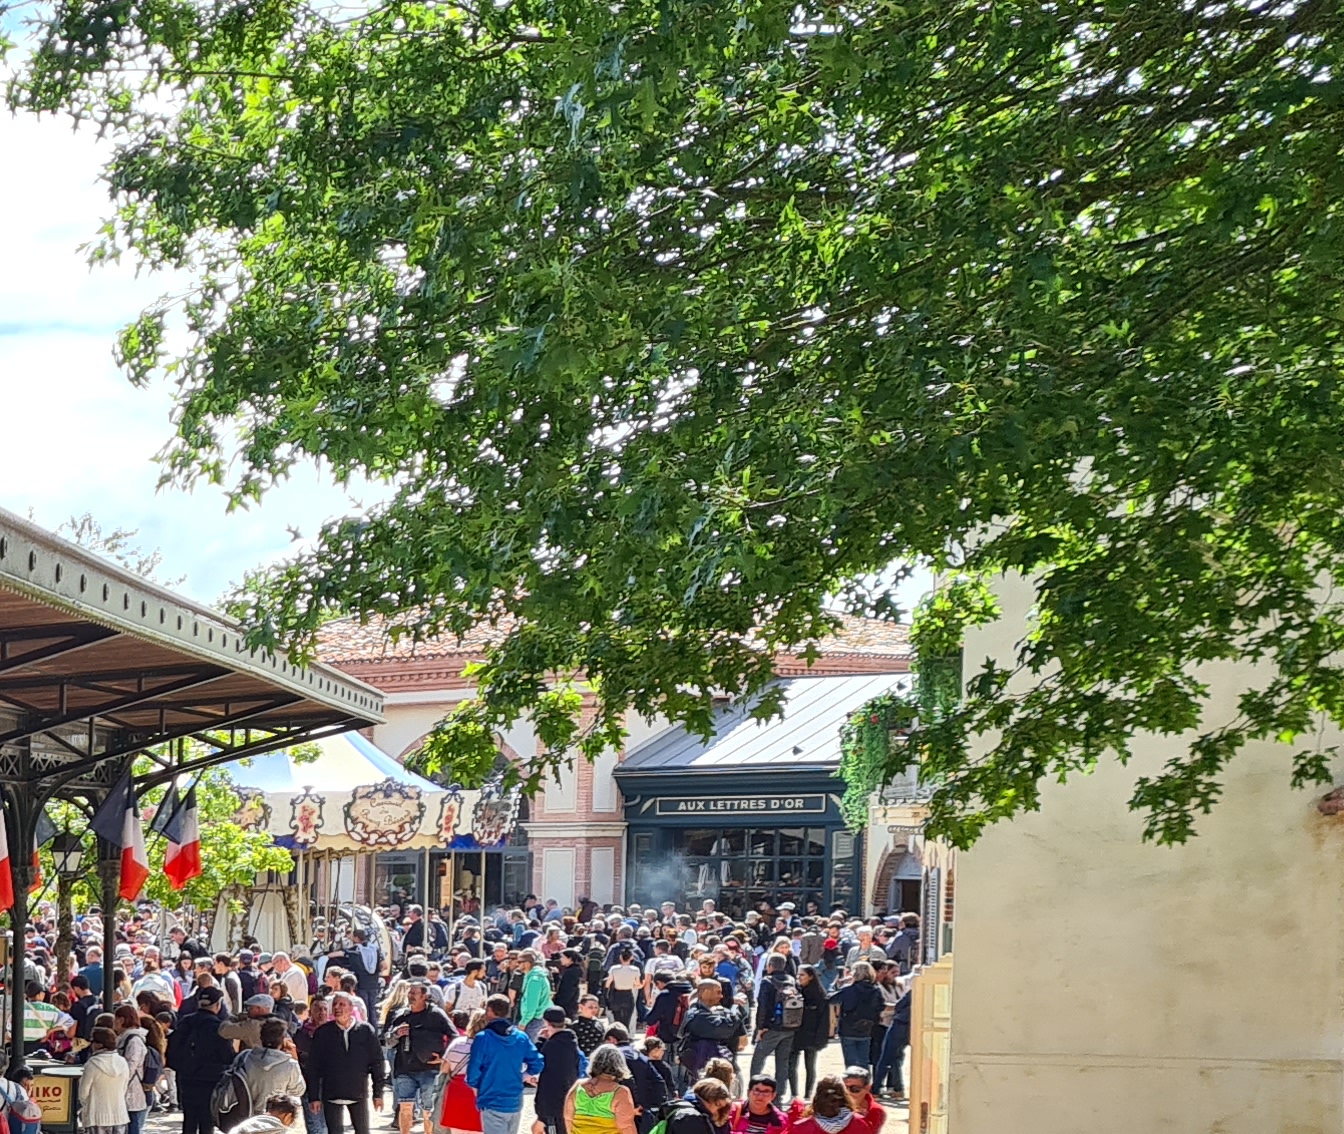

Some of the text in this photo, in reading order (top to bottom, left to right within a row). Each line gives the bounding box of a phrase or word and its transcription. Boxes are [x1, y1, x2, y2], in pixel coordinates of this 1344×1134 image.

[678, 798, 804, 811] AUX LETTRES D'OR
[29, 1086, 62, 1098] IKO
